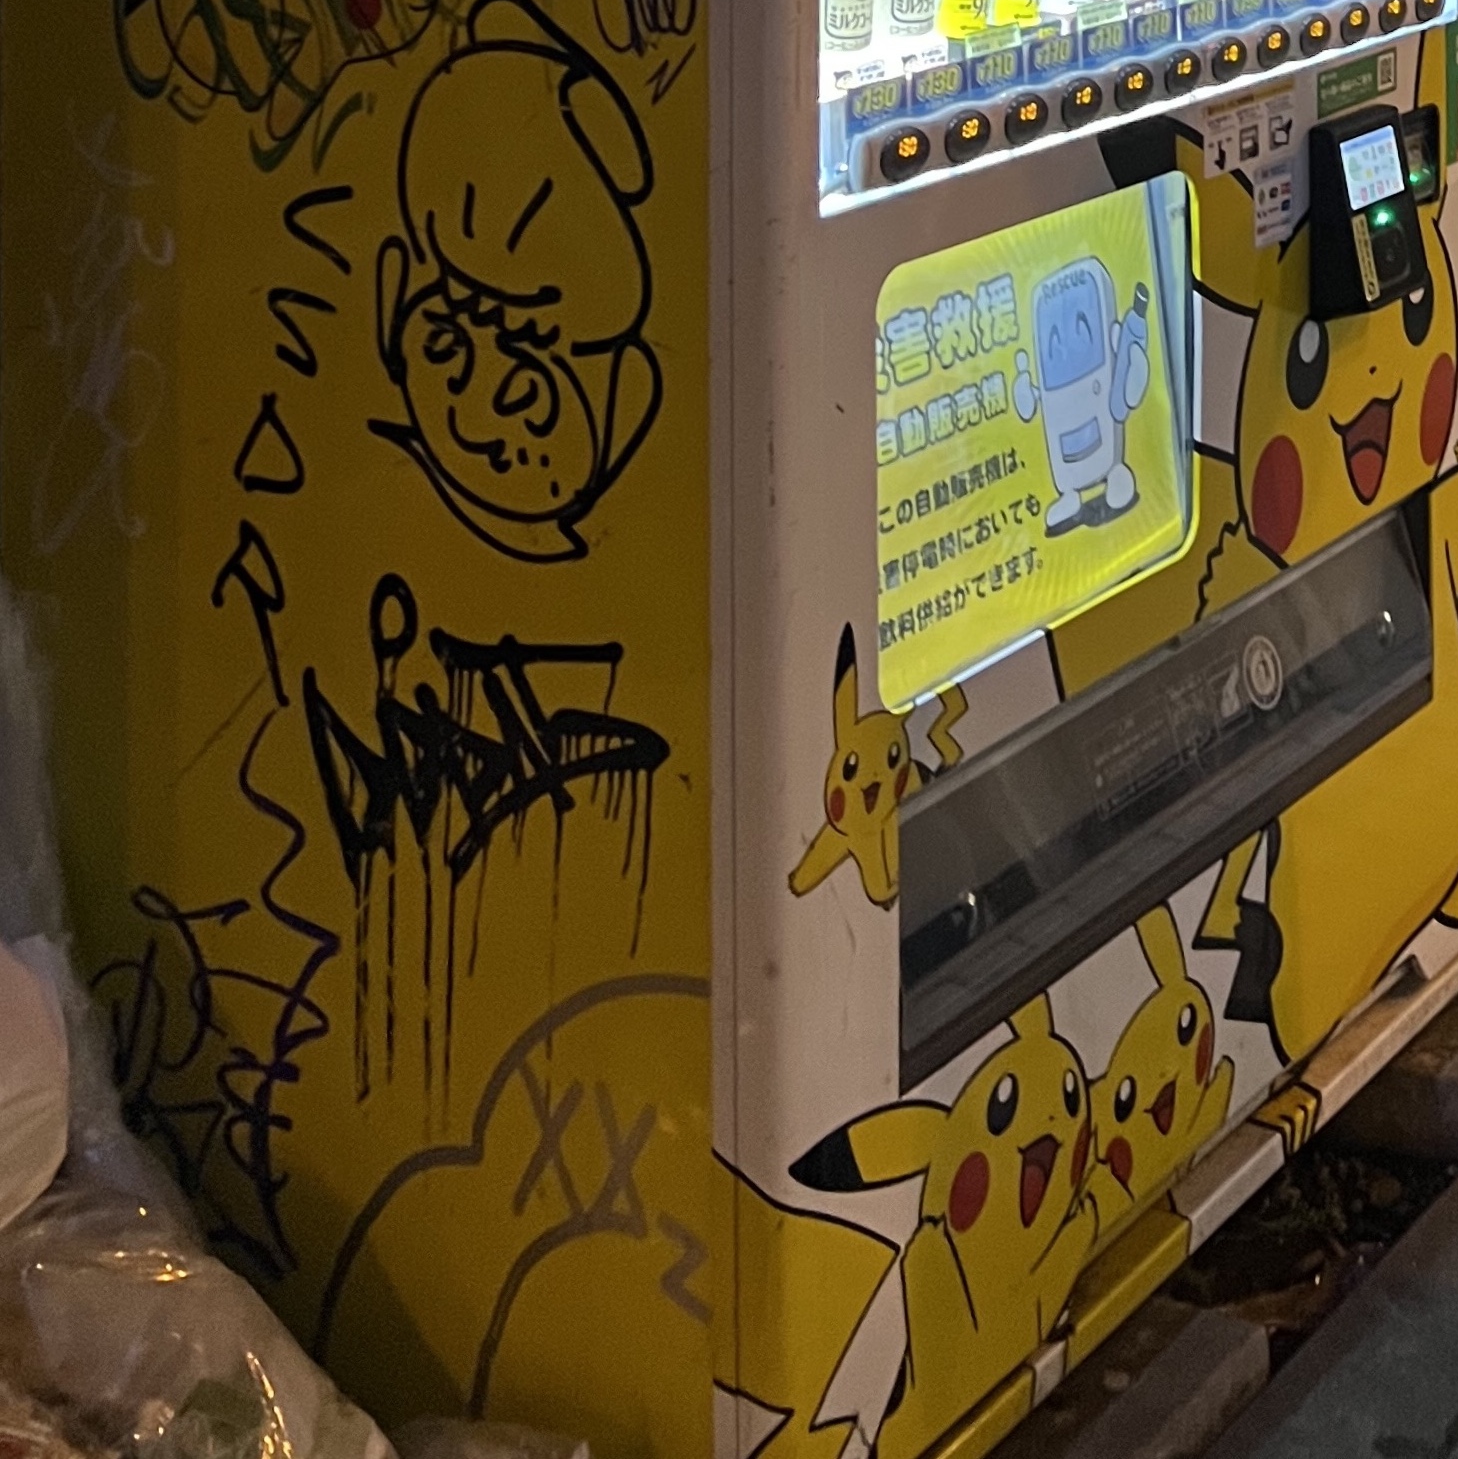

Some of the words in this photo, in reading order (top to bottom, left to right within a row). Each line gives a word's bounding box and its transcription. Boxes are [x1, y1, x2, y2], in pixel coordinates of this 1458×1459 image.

[876, 272, 1020, 395] 害救援
[876, 371, 1008, 467] 自動販売機
[878, 446, 1026, 535] この自動販売機は、
[878, 493, 1042, 594] 害停電時においても
[878, 545, 1044, 652] 飲料供給ができます。
